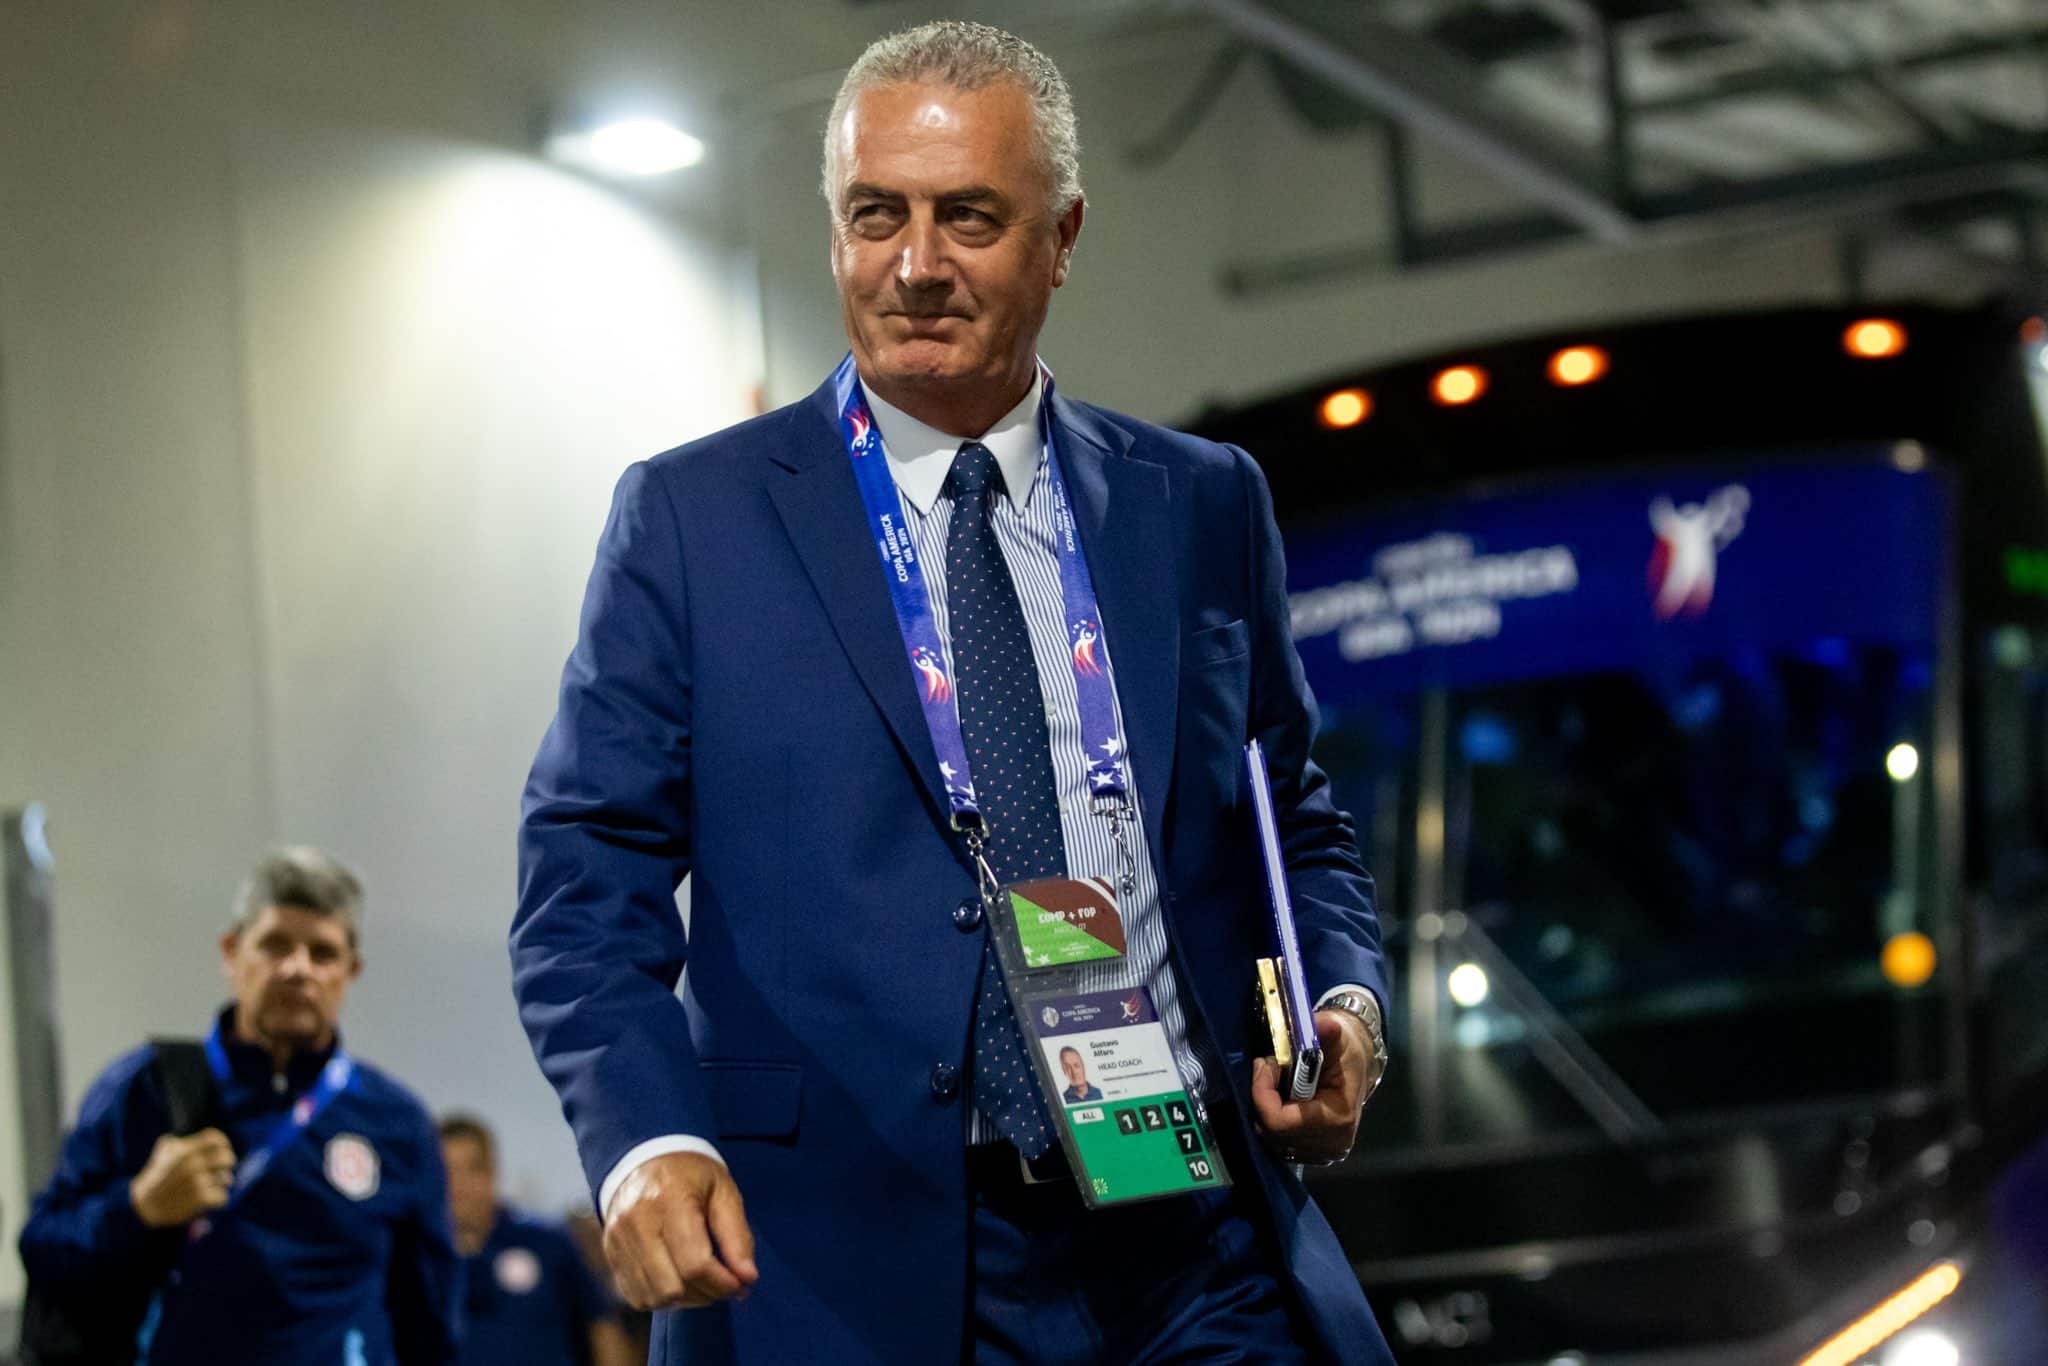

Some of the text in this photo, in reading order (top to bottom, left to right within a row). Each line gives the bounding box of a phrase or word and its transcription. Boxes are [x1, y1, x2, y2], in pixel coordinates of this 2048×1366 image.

[880, 513, 902, 556] AMERICA
[1062, 507, 1076, 552] AMERICA
[903, 546, 914, 564] USA
[893, 556, 909, 583] COPA
[1090, 1039, 1119, 1049] Gustavo
[1098, 1058, 1143, 1071] HEAD COACH
[1082, 1112, 1096, 1120] ALL
[1122, 1106, 1185, 1129] 1 2 4
[1182, 1133, 1192, 1149] 7
[1189, 1161, 1209, 1177] 10
